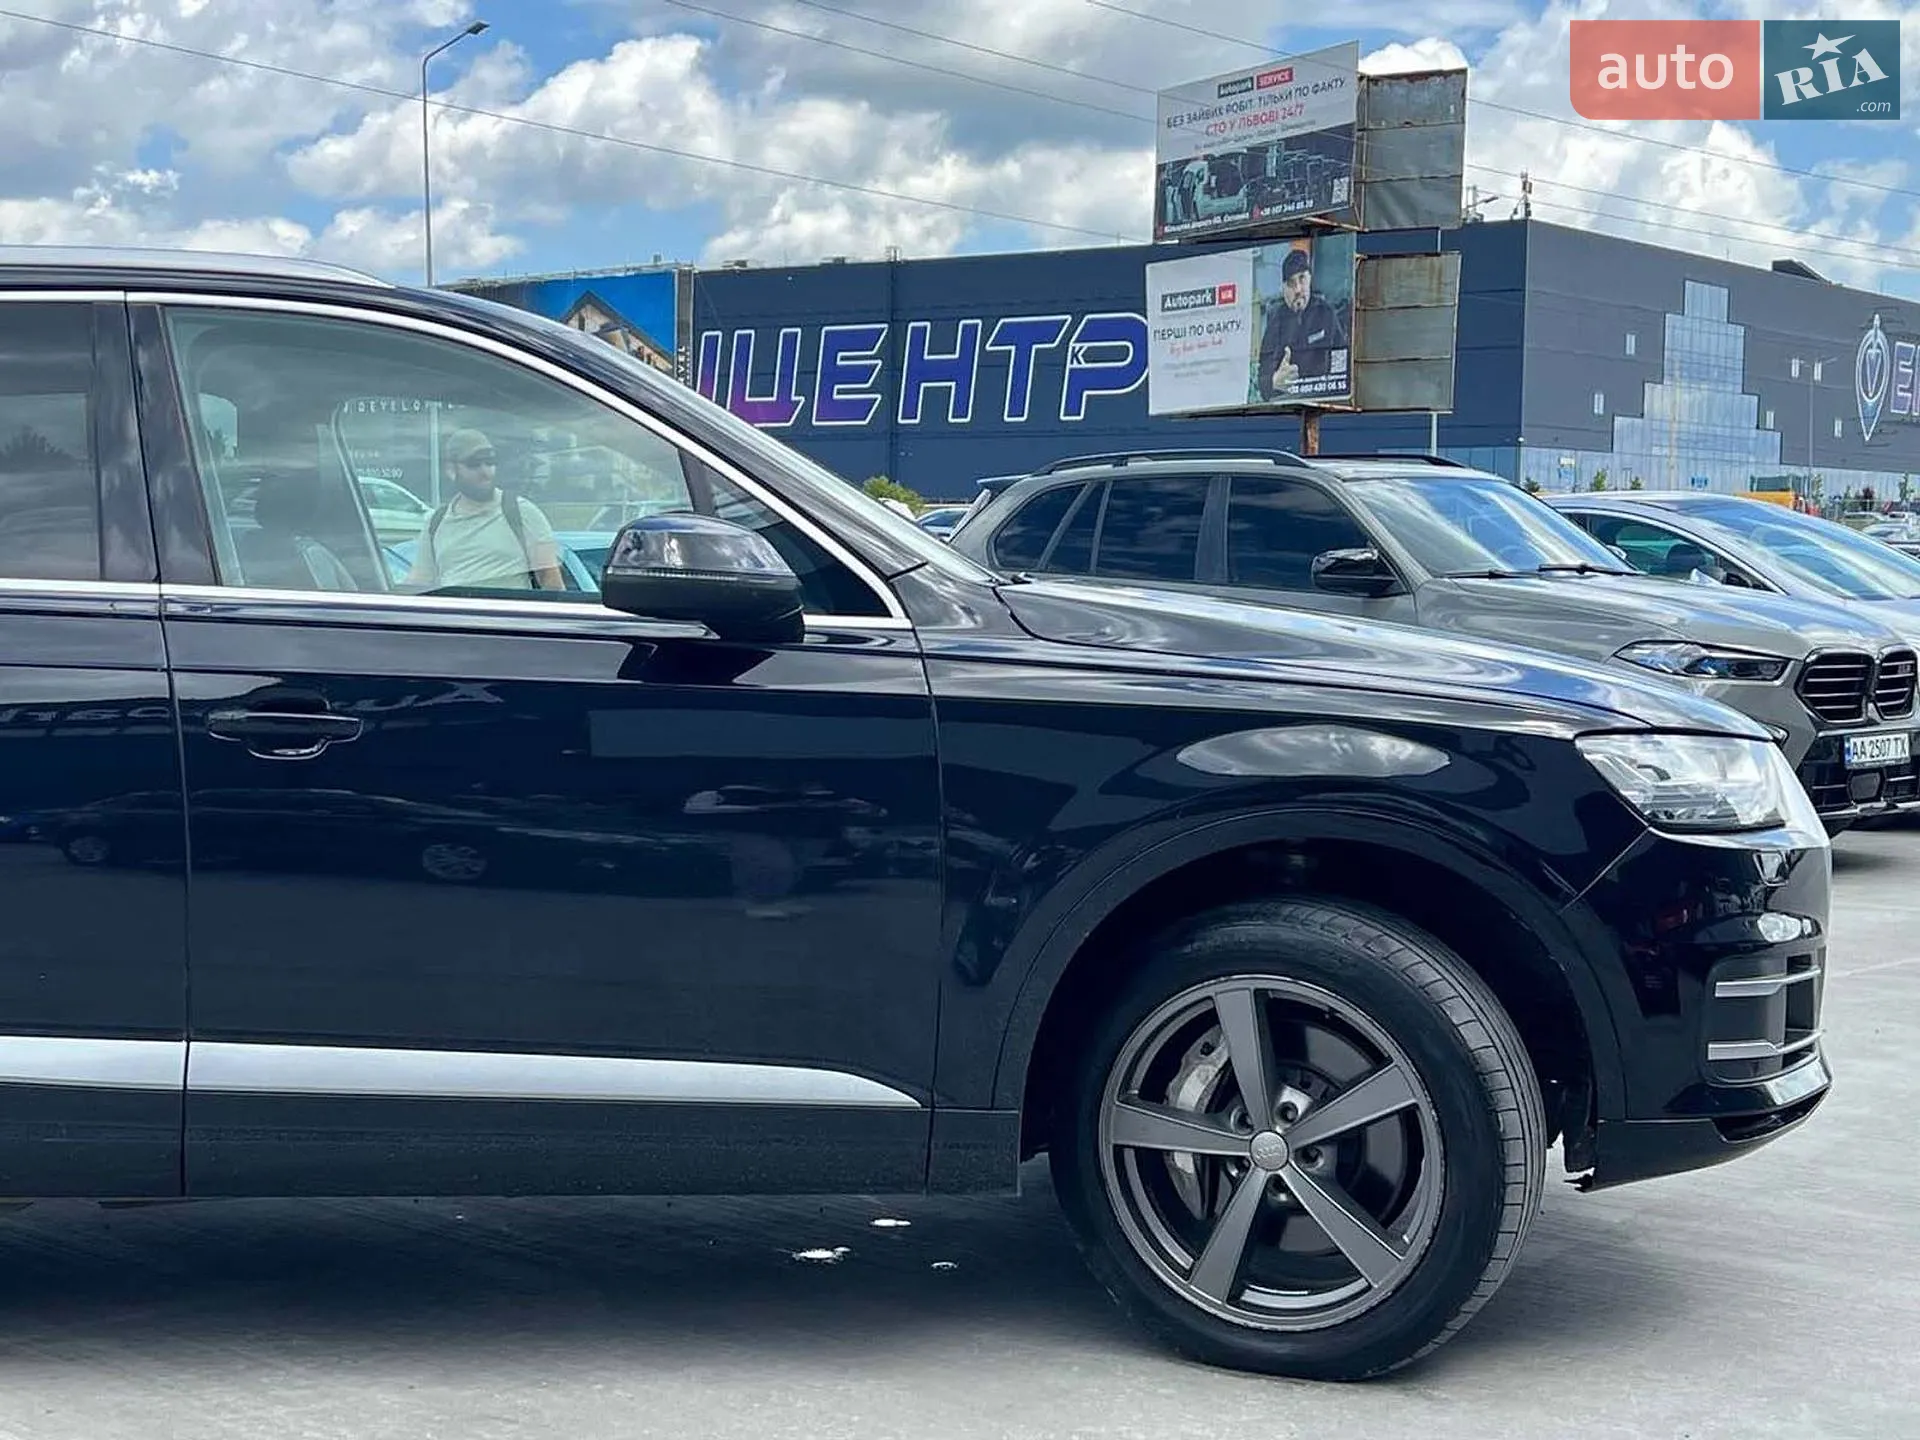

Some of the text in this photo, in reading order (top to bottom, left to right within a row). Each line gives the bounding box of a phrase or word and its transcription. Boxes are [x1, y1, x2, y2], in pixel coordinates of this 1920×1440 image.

[1259, 71, 1291, 88] SERVICE
[1167, 114, 1184, 128] БЕЗ
[1294, 86, 1309, 99] ПО
[1205, 120, 1227, 137] СТО
[1229, 118, 1236, 132] У
[1238, 109, 1279, 129] ЛЬВОВІ
[1281, 103, 1305, 121] 24/7
[1163, 289, 1212, 309] Autopark
[1153, 326, 1187, 341] ПЕРШІ
[1189, 323, 1204, 337] ПО
[1852, 735, 1907, 760] AA 2507 TX
